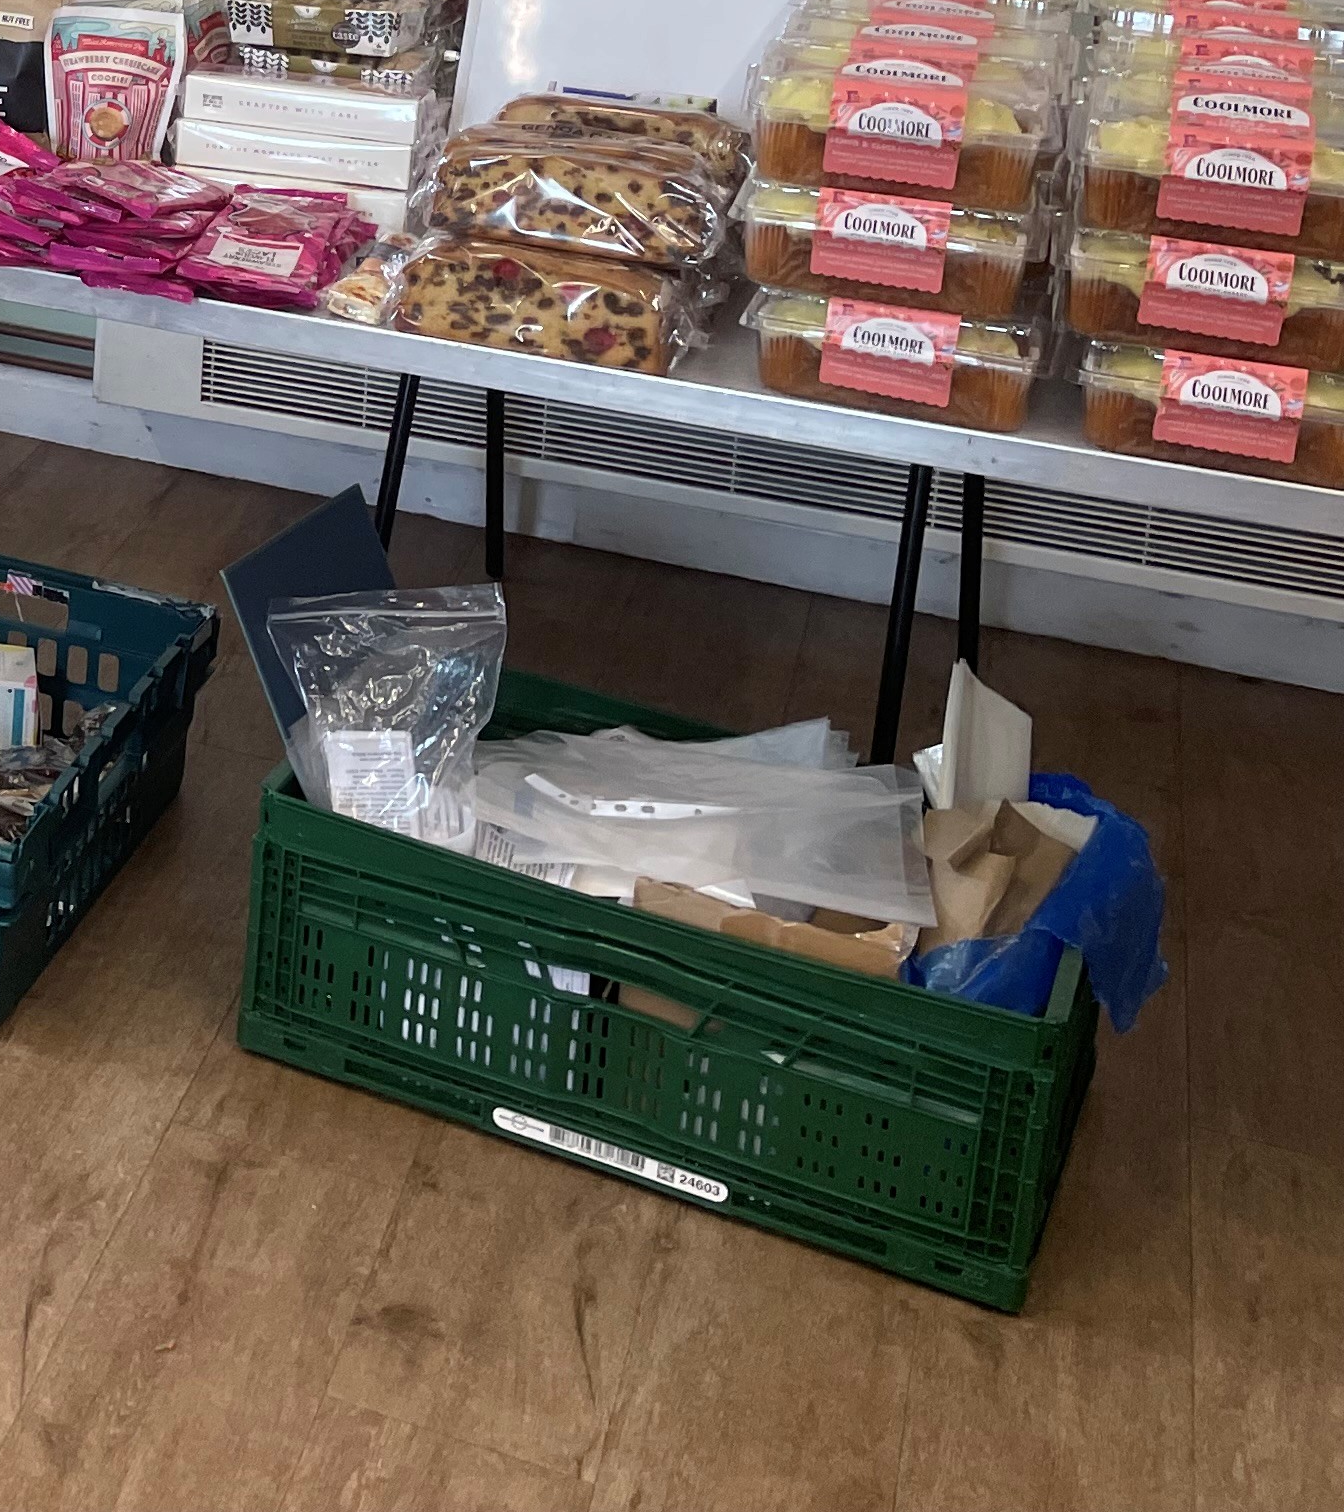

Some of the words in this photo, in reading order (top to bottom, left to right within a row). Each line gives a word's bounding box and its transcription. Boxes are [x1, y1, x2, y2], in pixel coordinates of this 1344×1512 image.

[332, 30, 359, 41] taste
[855, 63, 948, 85] COOLMORE
[1192, 95, 1294, 121] COOLMORE
[858, 112, 933, 140] COOLMORE
[1195, 156, 1277, 188] COOLMORE
[843, 210, 918, 240] COOLMORE
[1178, 261, 1257, 293] COOLMORE
[852, 324, 925, 356] COOLMORE
[1191, 378, 1270, 411] COOLMORE
[679, 1174, 721, 1196] 24603
